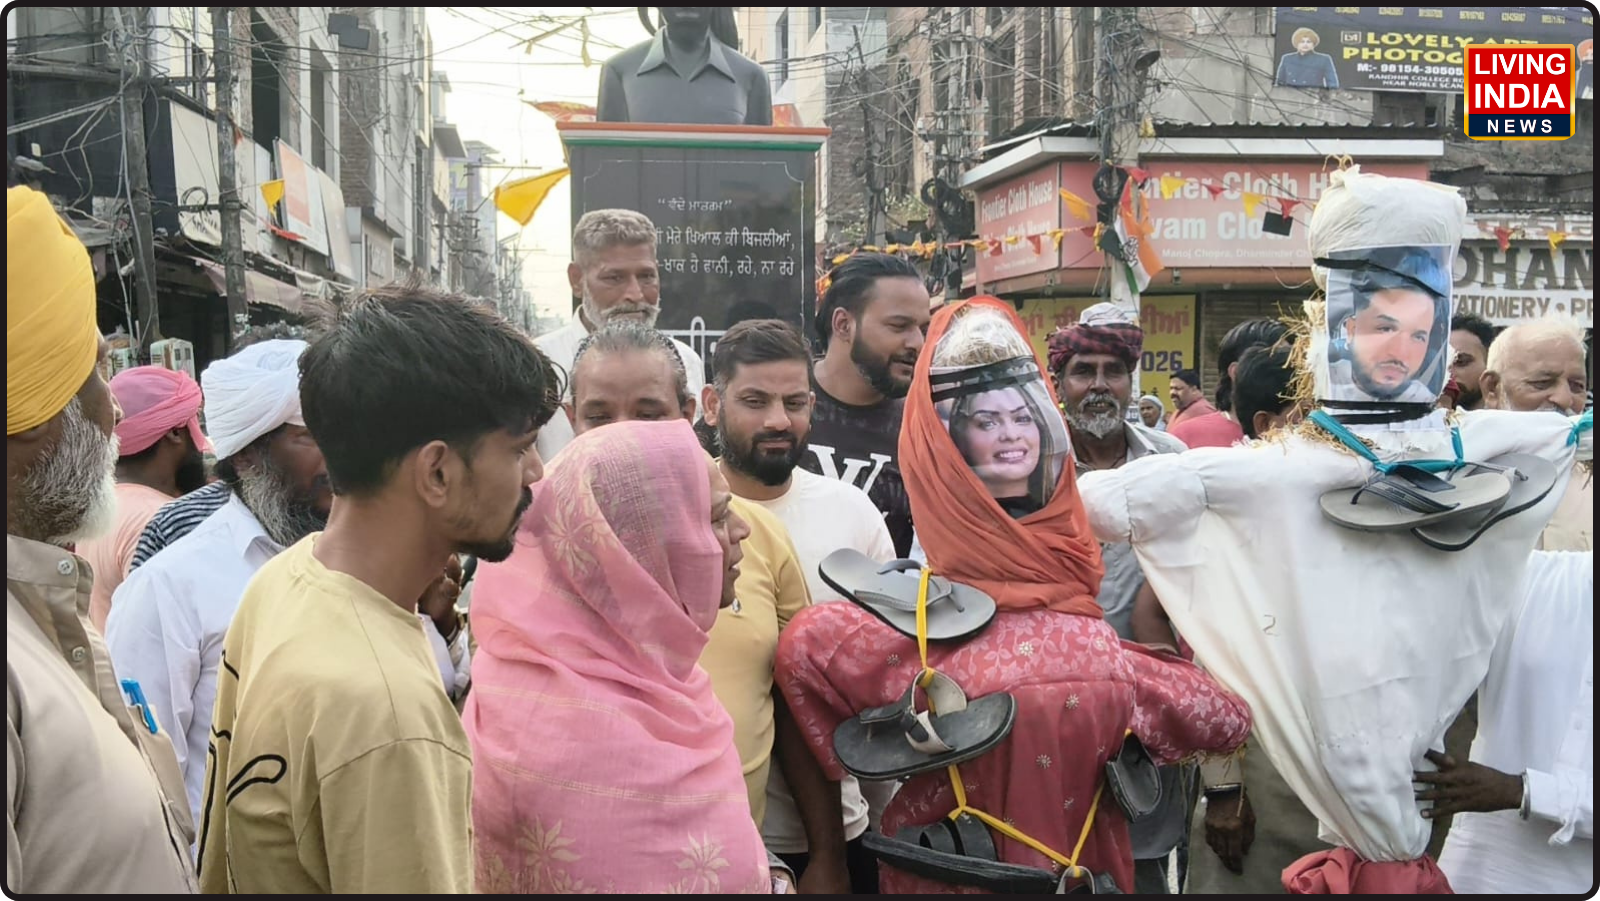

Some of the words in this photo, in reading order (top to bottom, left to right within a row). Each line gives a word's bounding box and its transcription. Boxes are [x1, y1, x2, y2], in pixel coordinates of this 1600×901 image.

[1366, 32, 1474, 48] LOVELY
[1412, 75, 1455, 83] COLLEGE
[1222, 172, 1299, 200] Cloth
[982, 194, 1006, 224] Frontier
[1008, 184, 1027, 215] Cloth
[1029, 180, 1052, 208] House
[724, 227, 739, 246] ਕੀ
[690, 253, 699, 273] ਹੈ
[761, 260, 775, 275] ਨਾ
[779, 256, 796, 276] ਰਹੇ
